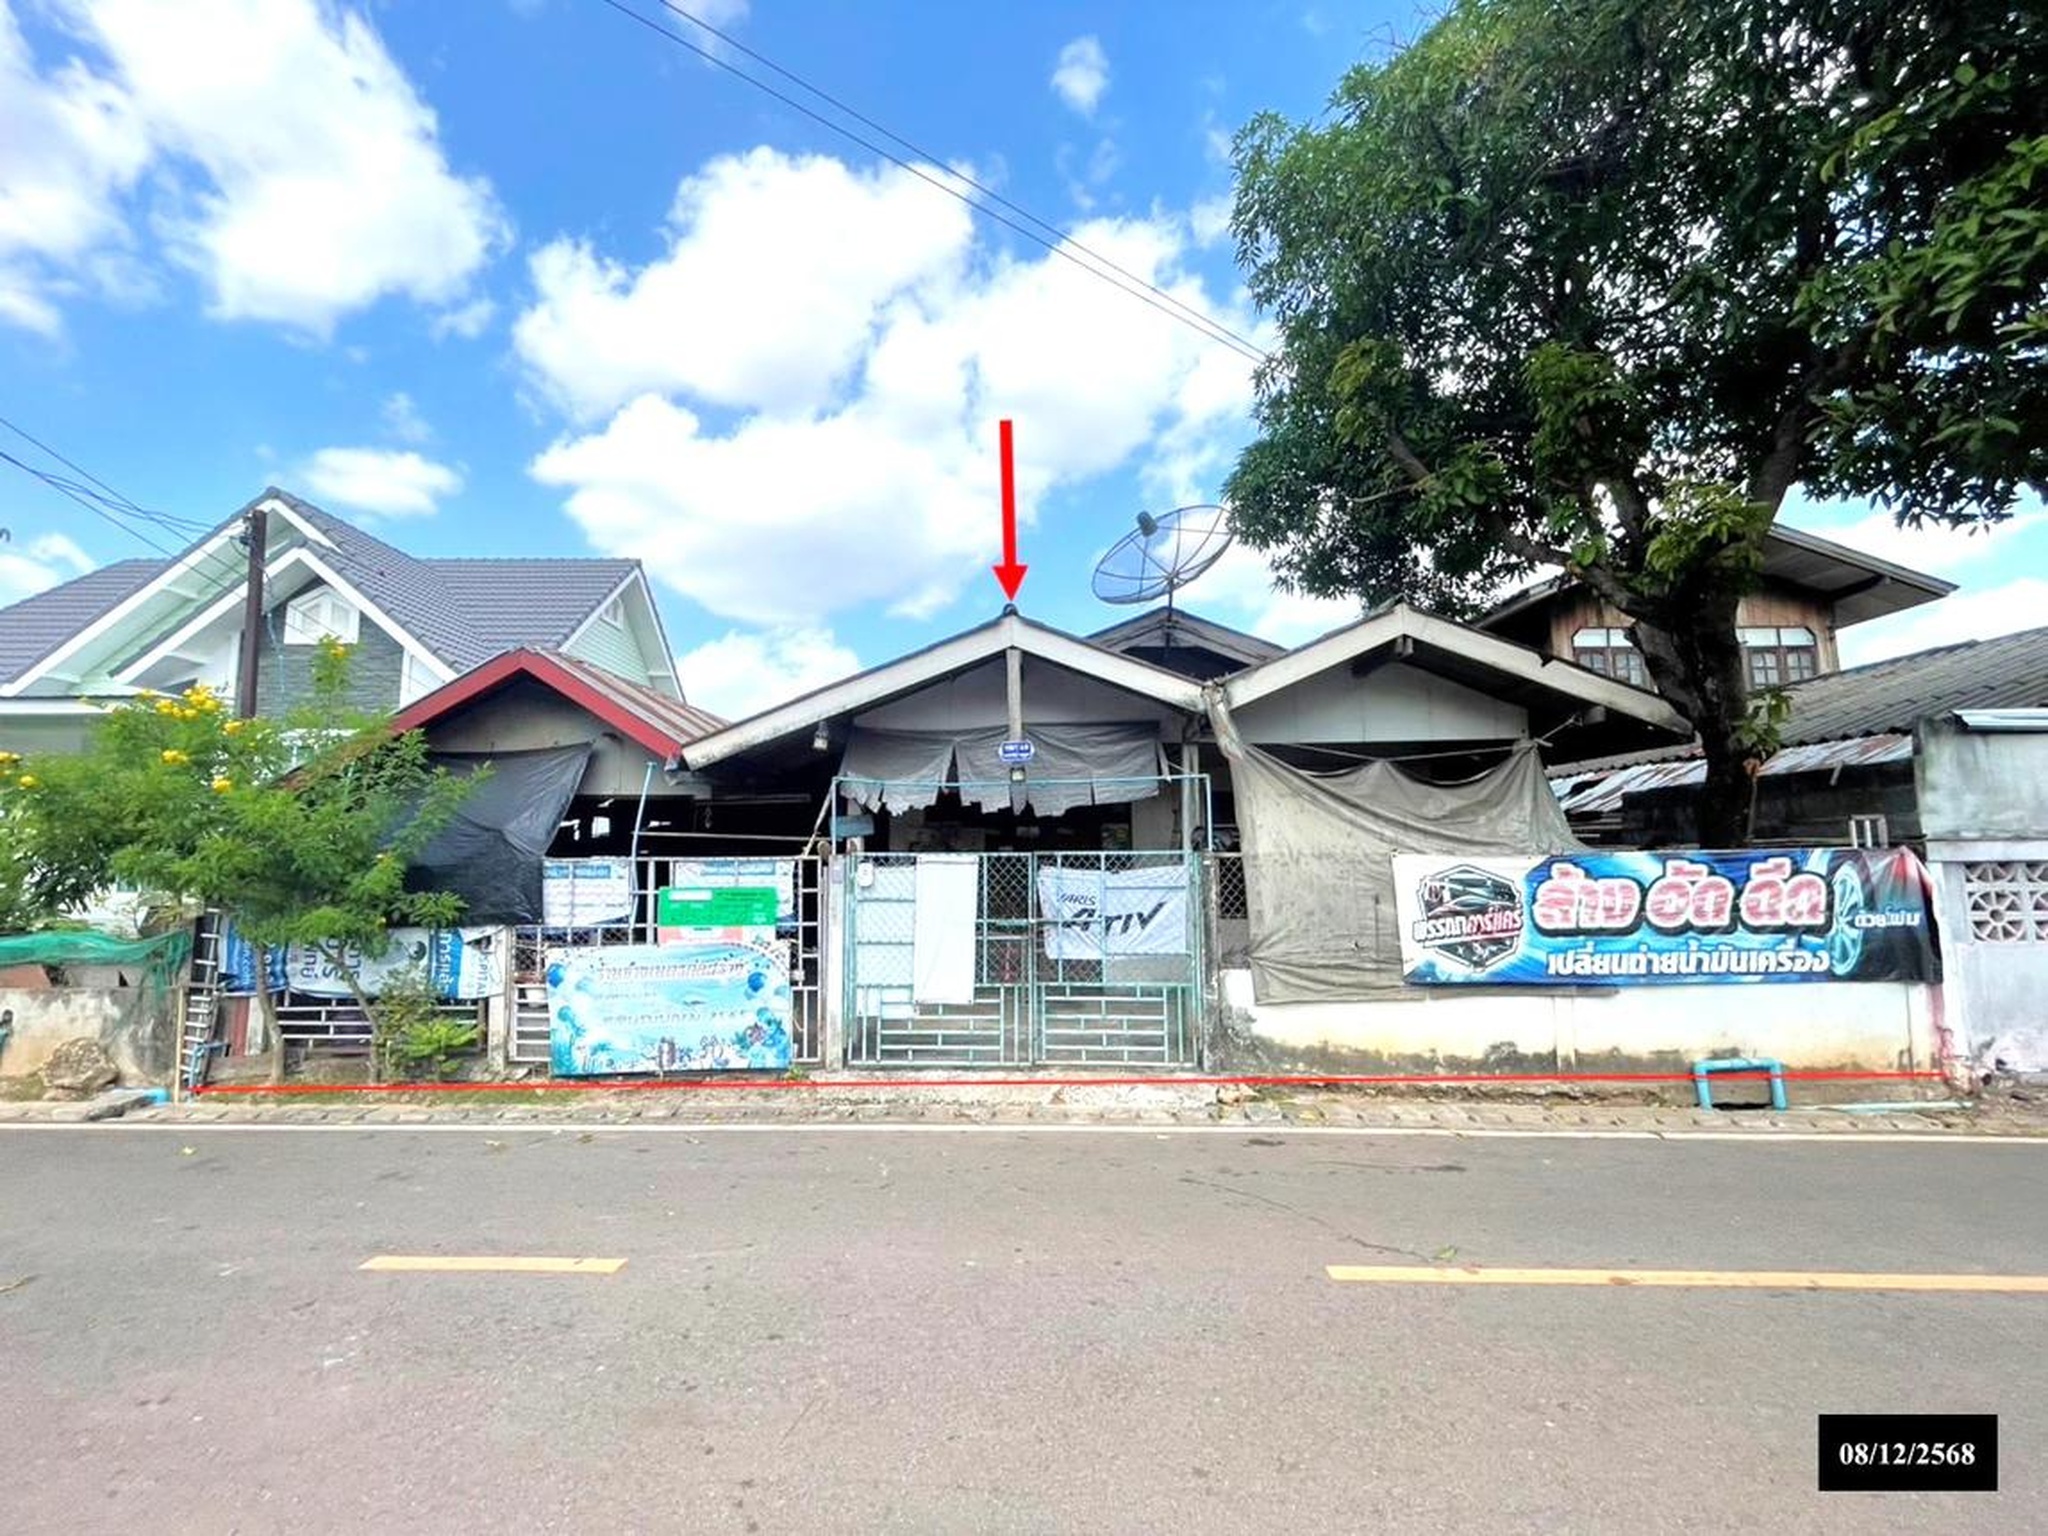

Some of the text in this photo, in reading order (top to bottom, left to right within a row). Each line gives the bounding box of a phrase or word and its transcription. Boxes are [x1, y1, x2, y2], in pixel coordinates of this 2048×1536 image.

[1647, 860, 1734, 927] อัด
[1741, 857, 1826, 925] ฉีด
[1547, 939, 1830, 975] เปลี่ยนถ่ายน้ำมันเครื่อง
